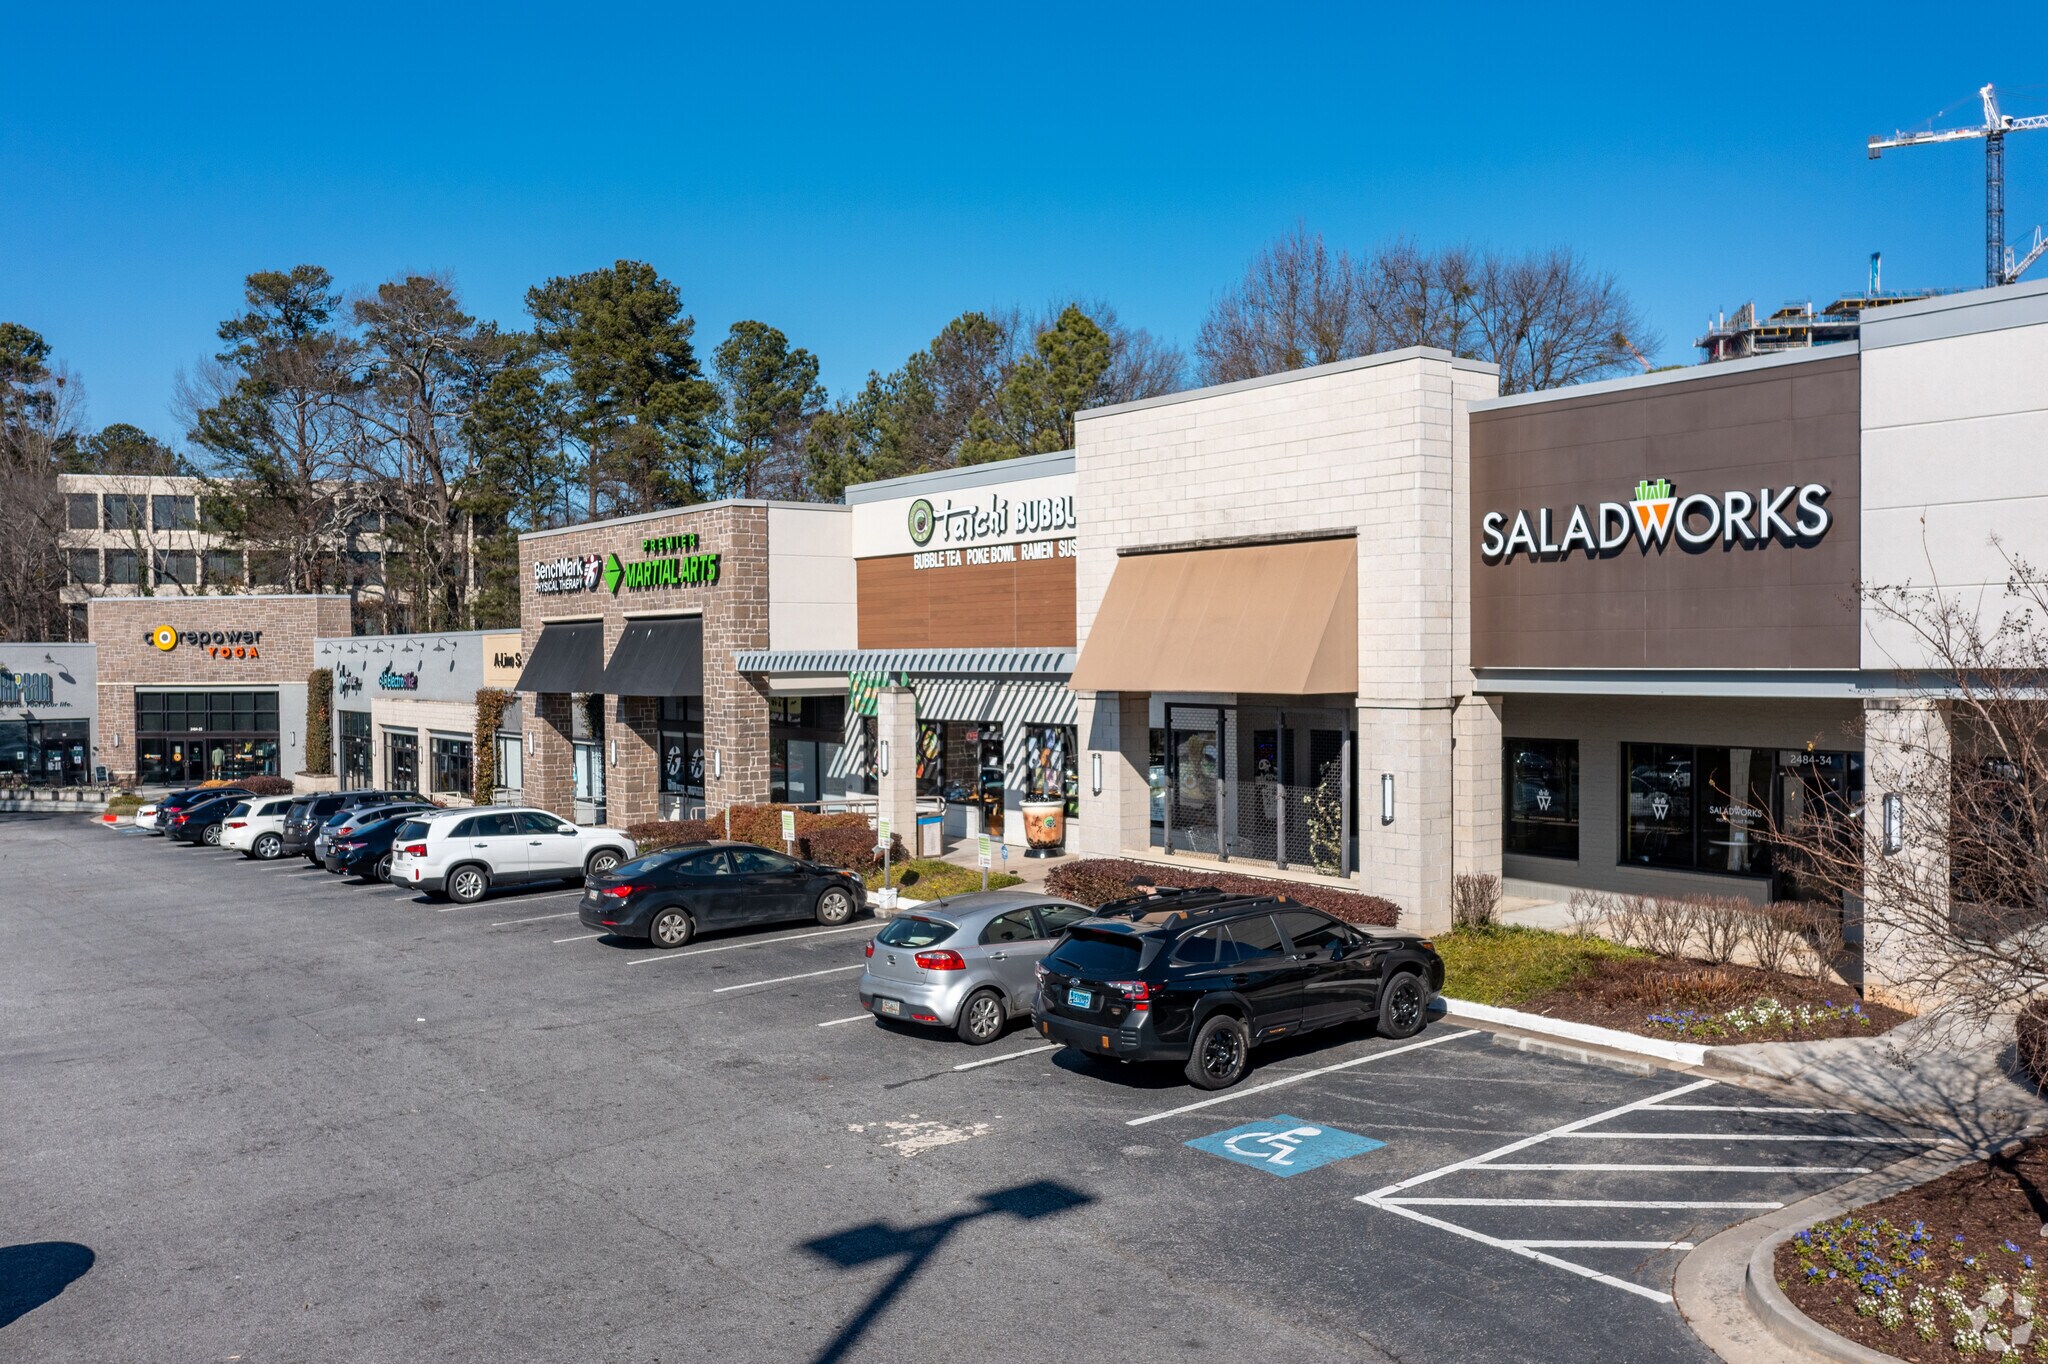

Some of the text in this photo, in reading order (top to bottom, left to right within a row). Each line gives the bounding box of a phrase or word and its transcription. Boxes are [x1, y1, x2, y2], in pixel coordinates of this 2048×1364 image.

[1481, 482, 1828, 557] SALADWORKS
[643, 533, 695, 551] PREMIER
[914, 539, 1077, 569] BUBBLE TEA POKE BOWL RAMEN SUS
[534, 555, 583, 580] BenchMark
[625, 554, 716, 587] MARTIAL ARTS
[535, 578, 584, 592] PHYSICAL THERAPY
[208, 647, 259, 658] YOGA
[1790, 754, 1832, 766] 2484-34
[1709, 805, 1762, 818] SALADWORKS
